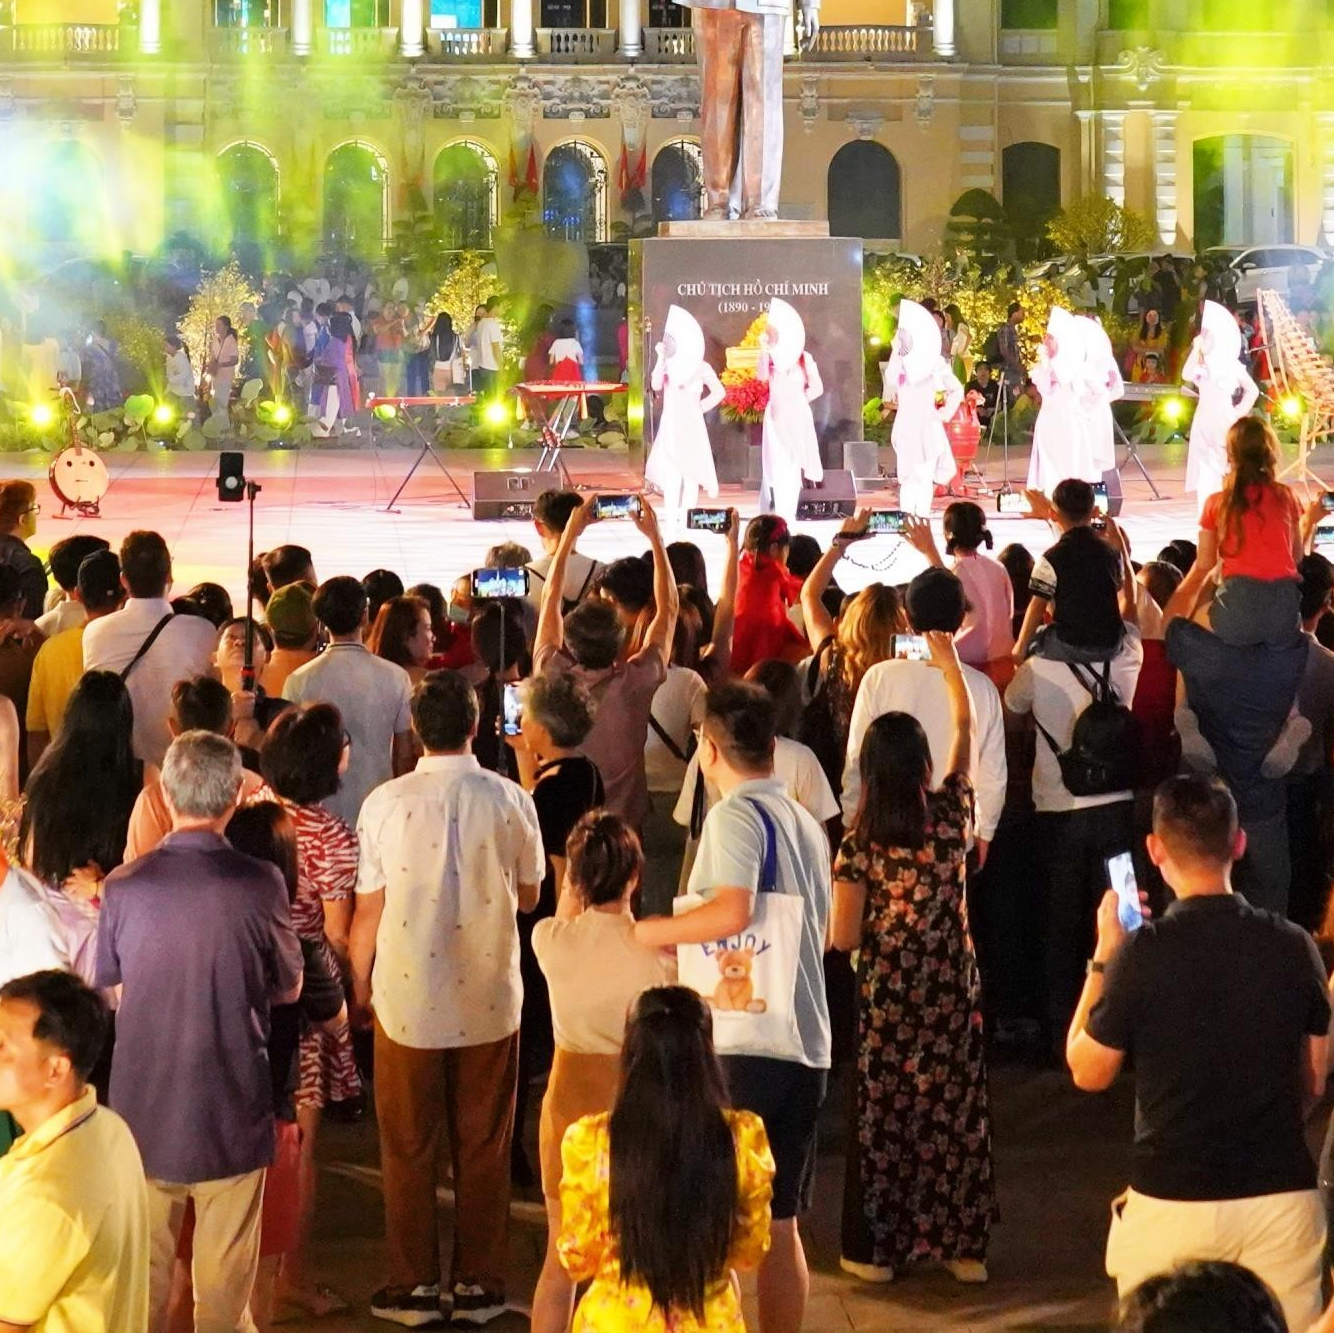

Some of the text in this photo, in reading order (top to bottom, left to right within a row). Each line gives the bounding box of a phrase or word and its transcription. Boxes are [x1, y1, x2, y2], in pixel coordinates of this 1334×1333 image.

[677, 278, 829, 298] CHỦ TỊCH HỒ CHÍ MINH
[718, 301, 749, 315] (1890
[700, 933, 772, 956] ENJOY
